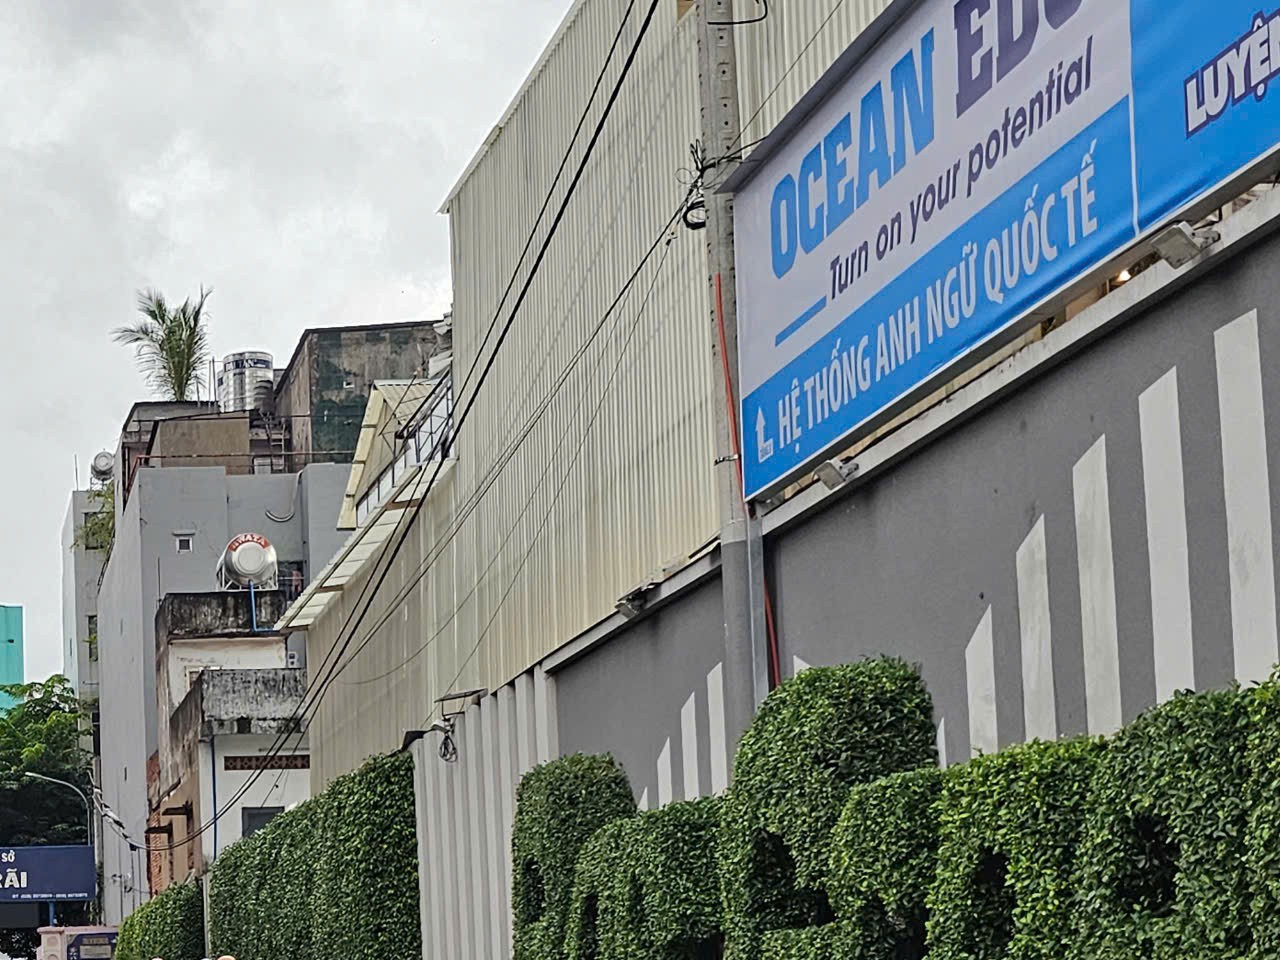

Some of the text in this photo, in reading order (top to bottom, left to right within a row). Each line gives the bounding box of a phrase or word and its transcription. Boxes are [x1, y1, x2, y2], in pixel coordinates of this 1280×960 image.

[770, 0, 1082, 279] OCEAN ED
[830, 36, 1093, 300] Turn on your potential
[779, 139, 1099, 454] HỆ THỐNG ANH NGỮ QUỐC TẾ
[1, 850, 15, 863] SỞ
